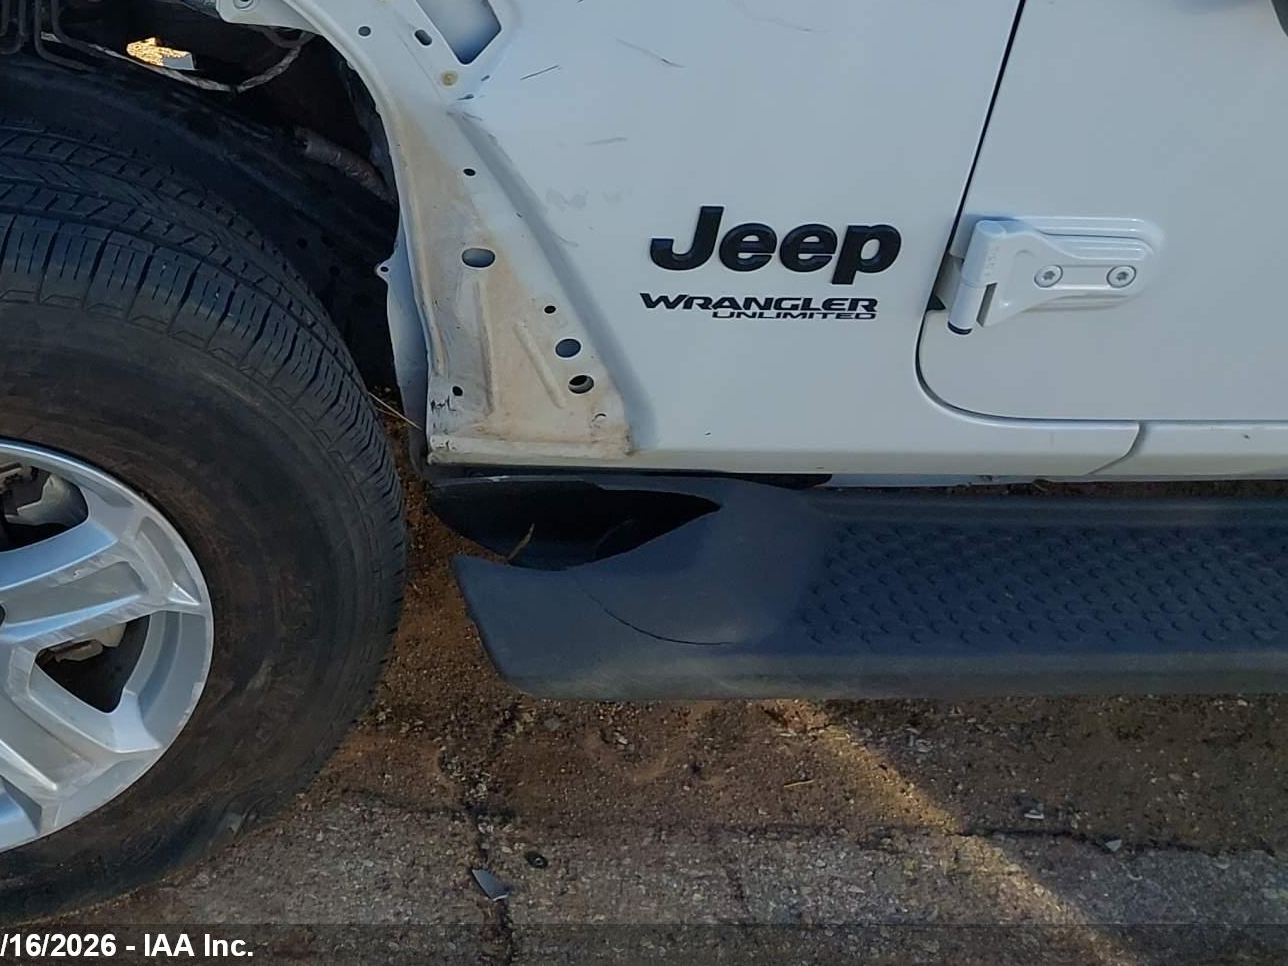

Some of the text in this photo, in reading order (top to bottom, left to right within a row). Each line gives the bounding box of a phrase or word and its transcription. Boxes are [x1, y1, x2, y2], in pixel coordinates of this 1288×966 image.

[649, 205, 902, 285] Jeep
[639, 292, 879, 313] WRANGLER
[711, 311, 877, 321] UNLIMITED
